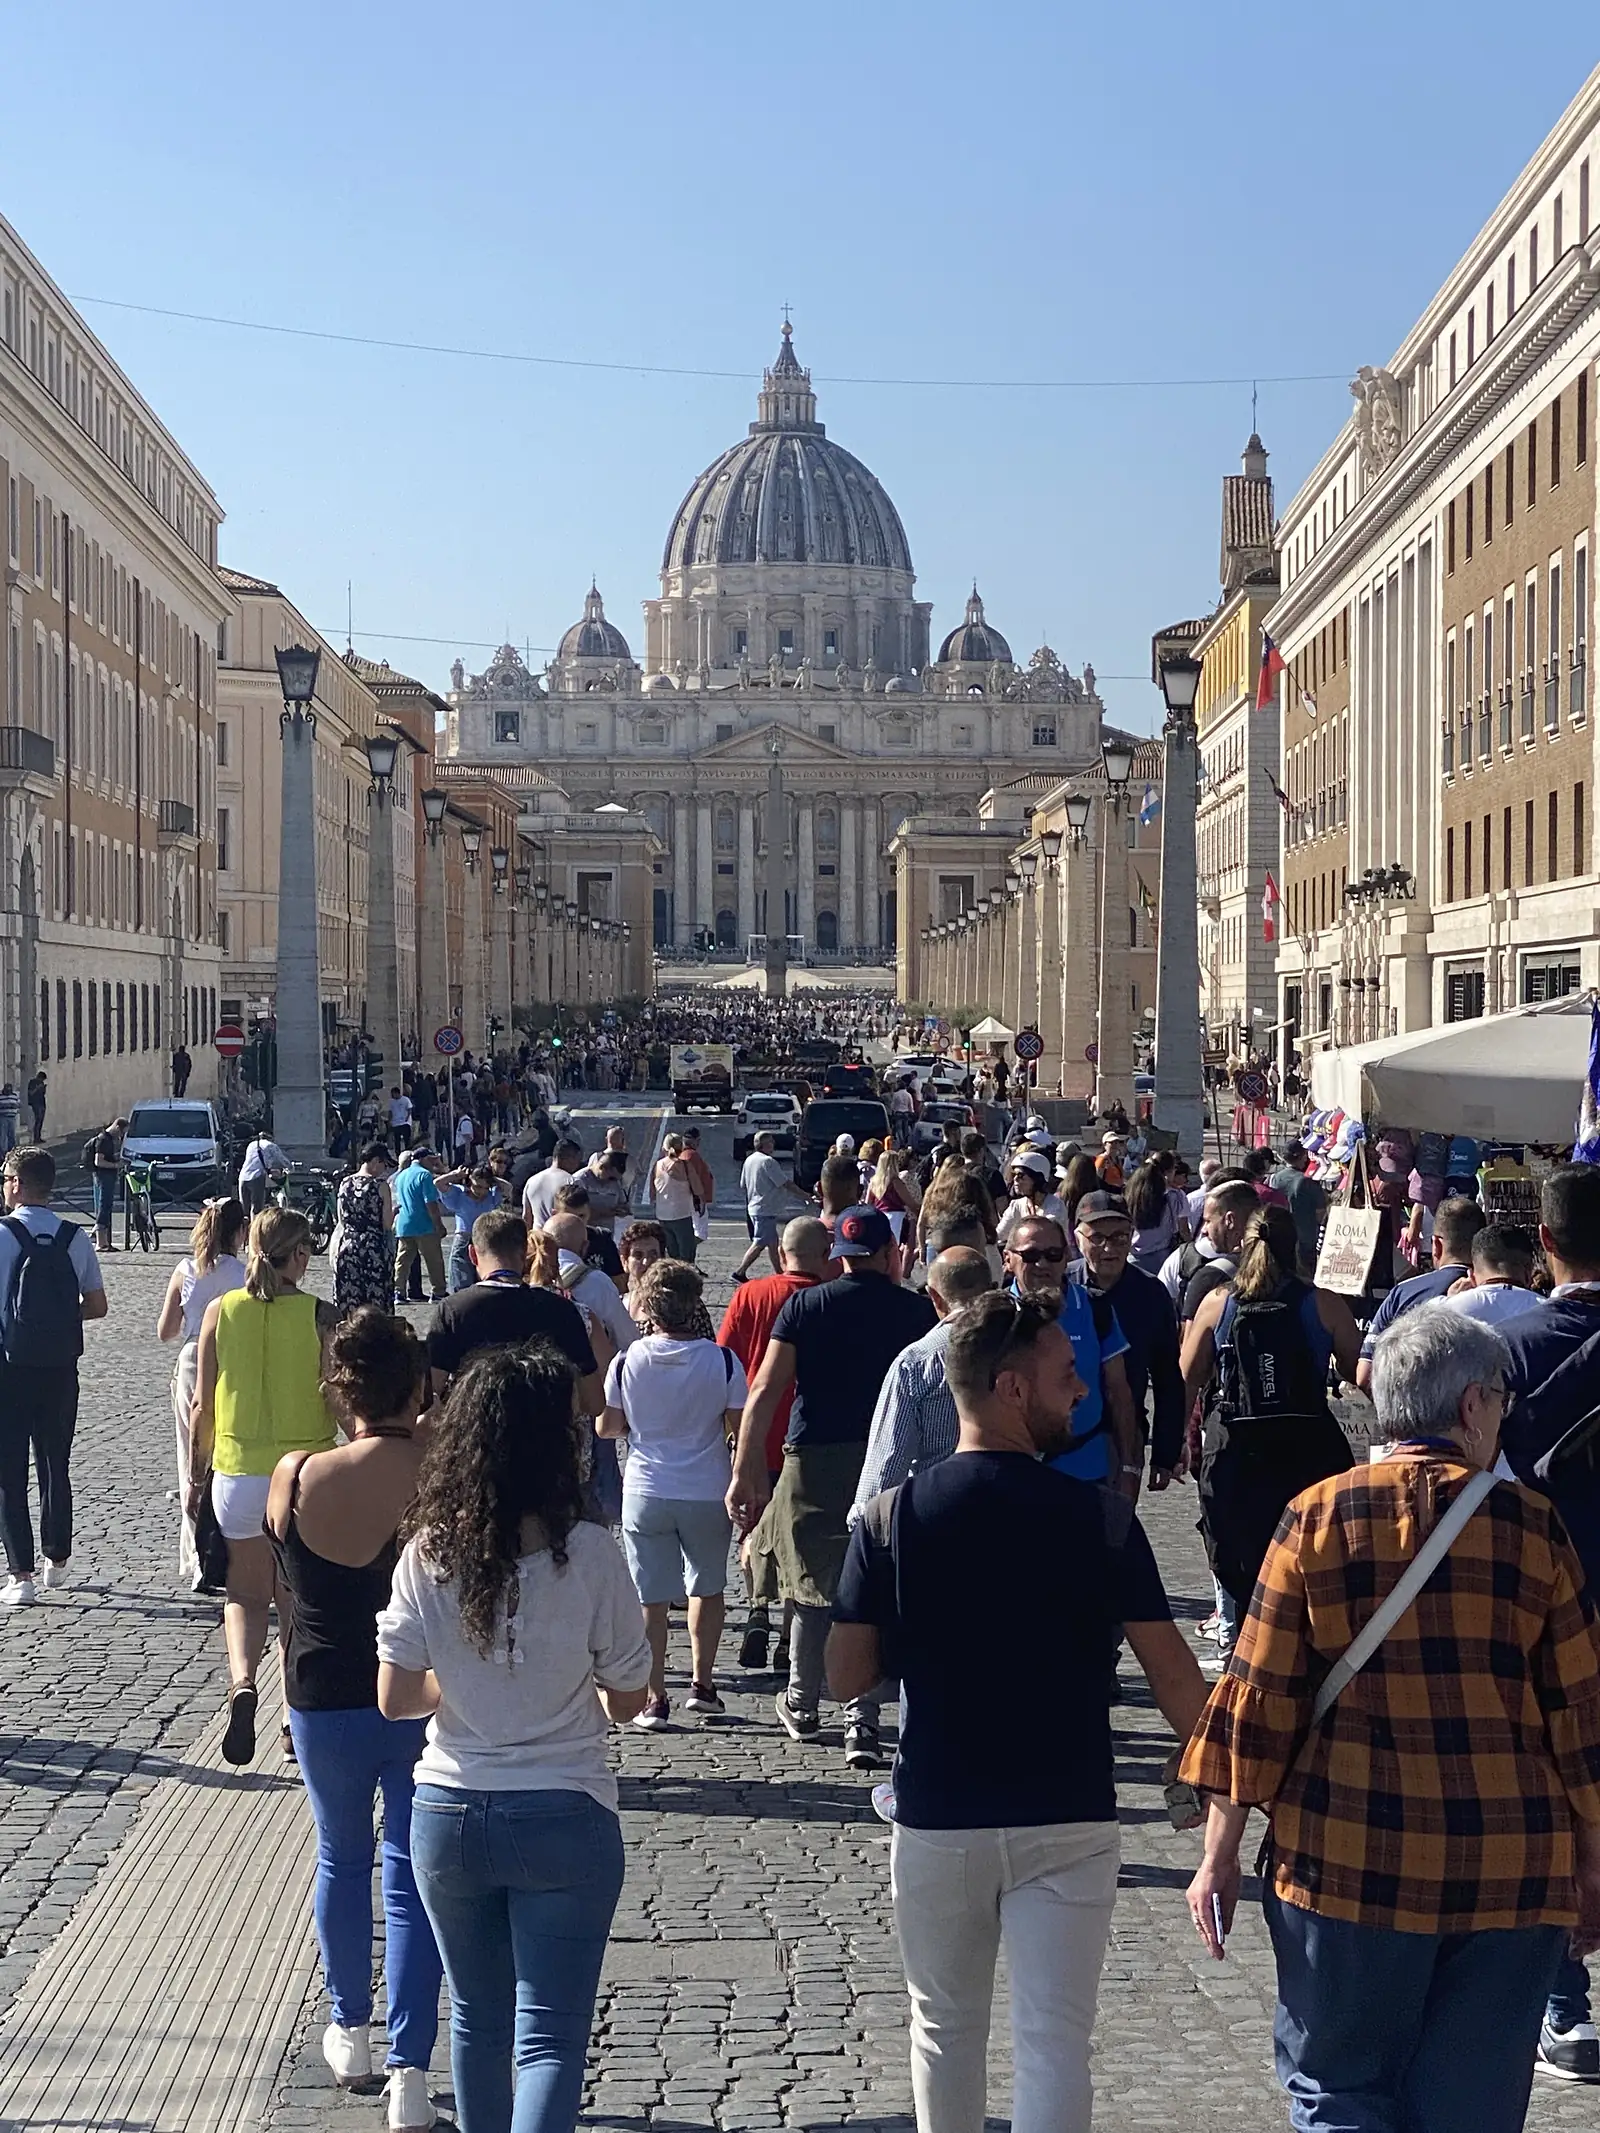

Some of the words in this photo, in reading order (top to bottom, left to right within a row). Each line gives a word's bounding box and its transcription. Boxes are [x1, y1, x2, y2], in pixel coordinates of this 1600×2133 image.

[1334, 1224, 1367, 1237] ROMA
[1264, 1353, 1276, 1398] AVATEL
[1339, 1421, 1370, 1435] OMA
